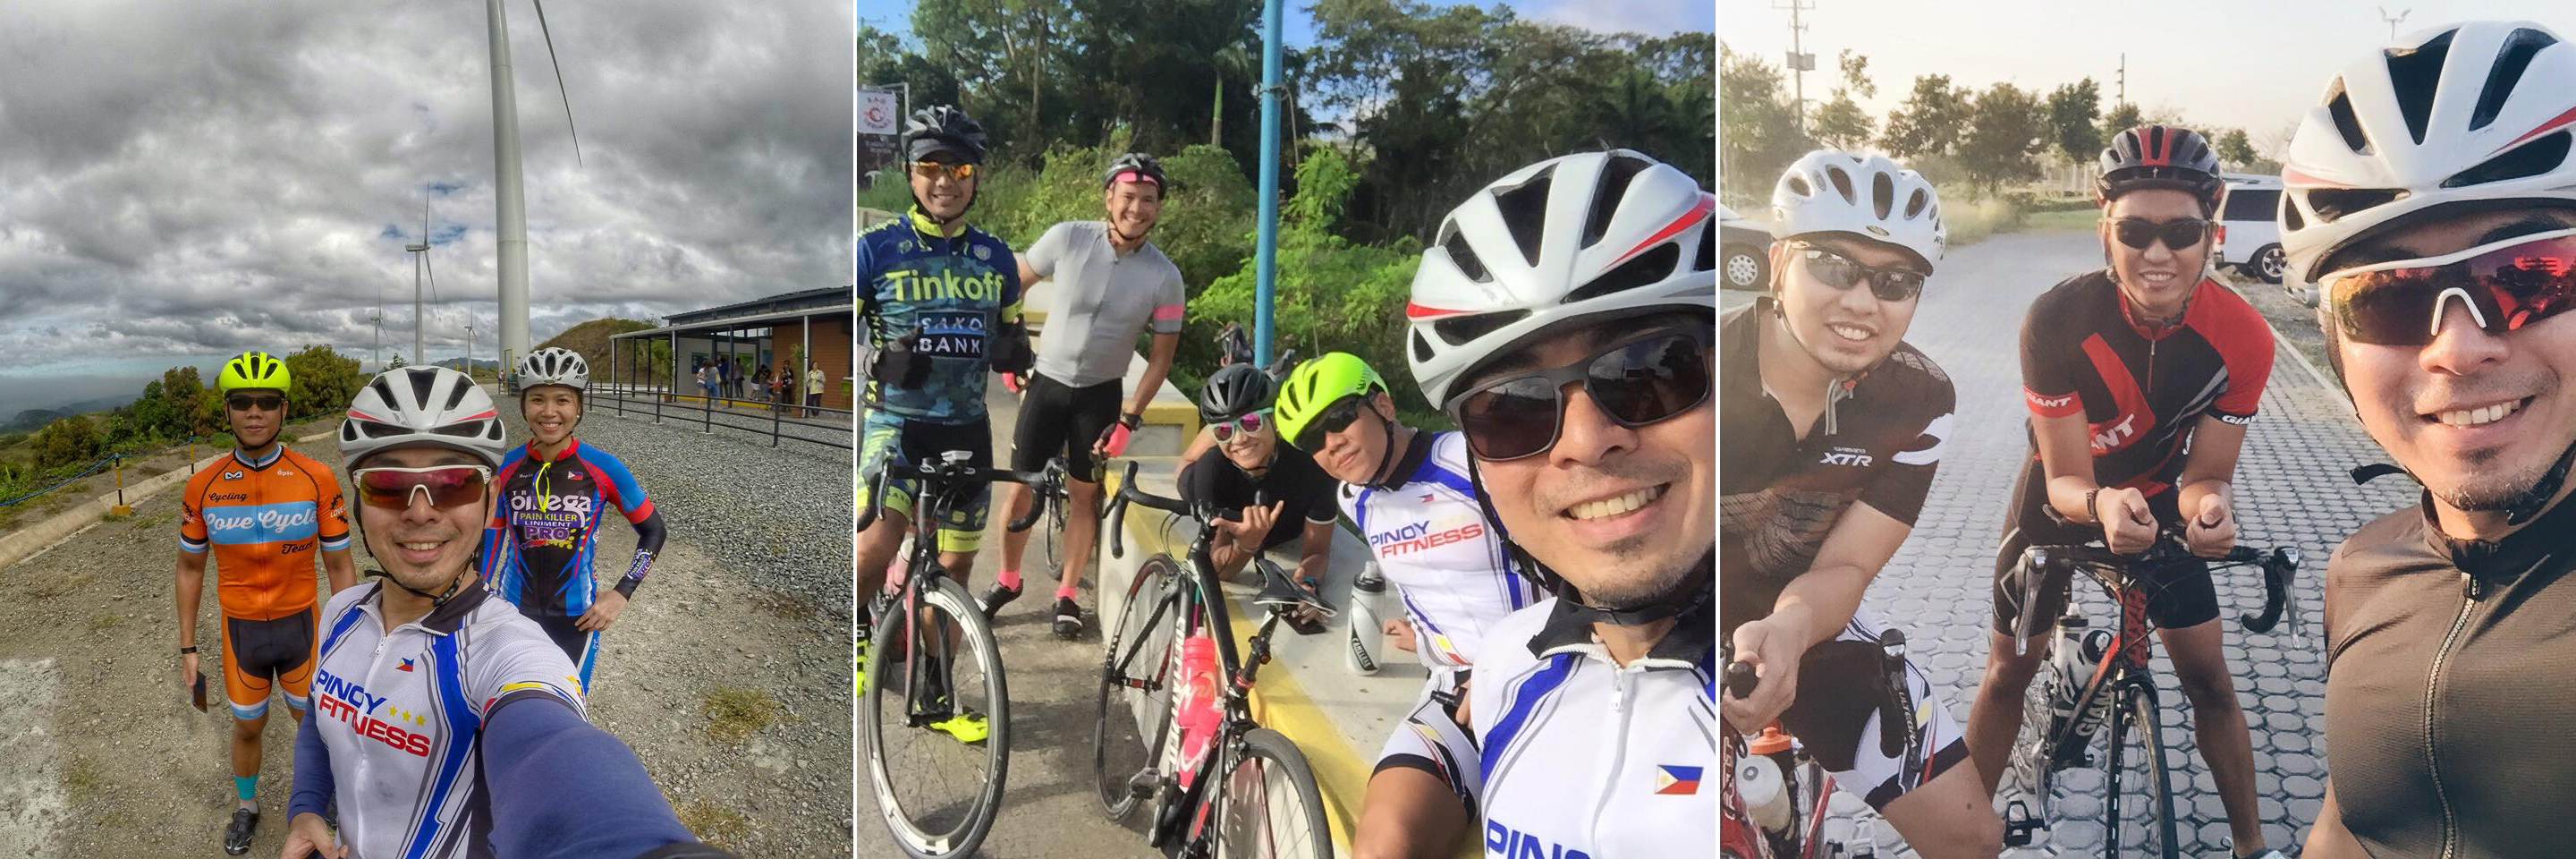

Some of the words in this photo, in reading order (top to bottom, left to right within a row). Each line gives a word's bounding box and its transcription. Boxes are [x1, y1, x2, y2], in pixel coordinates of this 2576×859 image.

[885, 269, 1004, 302] Tinkoff
[922, 317, 983, 331] SAXO
[919, 337, 981, 354] BANK
[1819, 452, 1873, 467] XTR
[208, 492, 248, 503] Cycling
[204, 513, 255, 535] Love
[520, 512, 542, 520] PAIN
[545, 513, 577, 522] KILLER
[524, 525, 570, 540] PRO
[1370, 520, 1430, 546] PINOY
[1381, 523, 1483, 558] FITNESS
[282, 540, 313, 555] Team
[315, 668, 387, 716] PINOY
[318, 693, 431, 758] FITNESS
[1486, 817, 1591, 859] PIN
